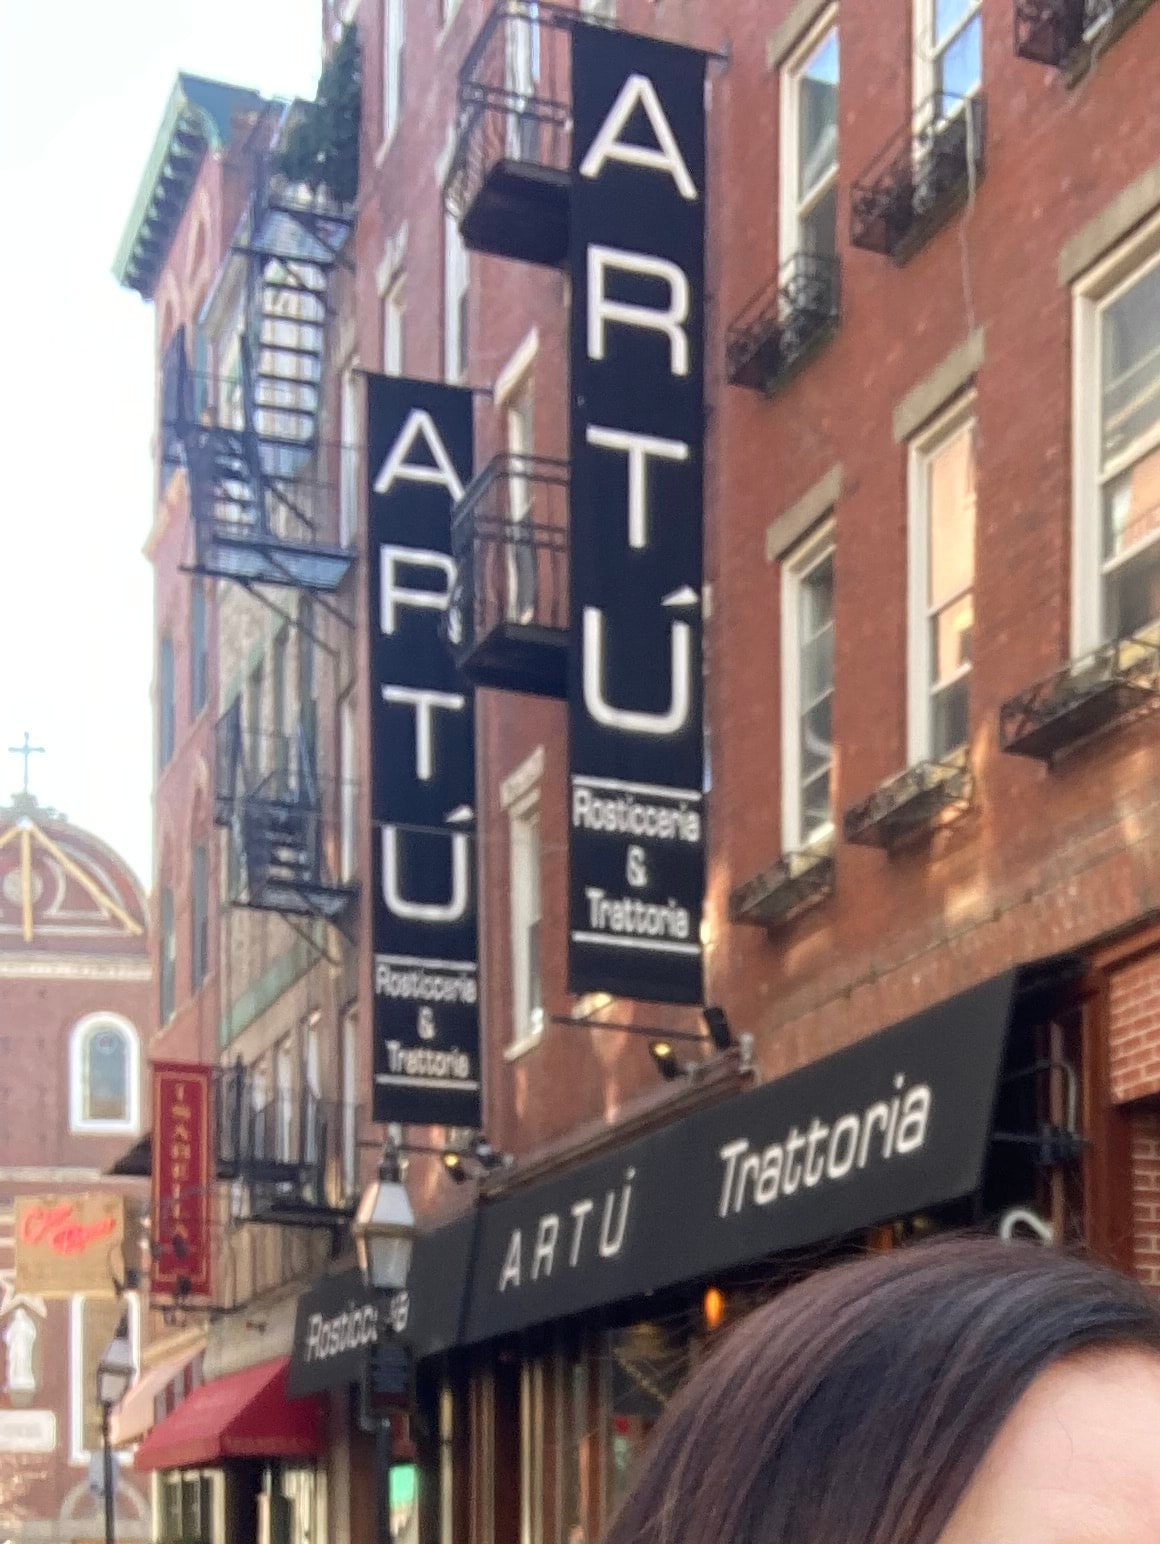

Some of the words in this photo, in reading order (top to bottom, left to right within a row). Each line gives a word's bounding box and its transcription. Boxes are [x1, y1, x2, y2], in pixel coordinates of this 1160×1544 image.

[578, 72, 699, 736] ARTÚ
[373, 406, 474, 922] ARTÚ
[572, 787, 700, 843] Rosticceria
[626, 844, 647, 888] &
[584, 886, 689, 940] Trattoria
[375, 964, 478, 1005] Rosticceria
[416, 1004, 436, 1041] &
[384, 1039, 471, 1079] Trattoria
[499, 1165, 637, 1293] ARTÚ
[717, 1071, 933, 1219] Trattoria
